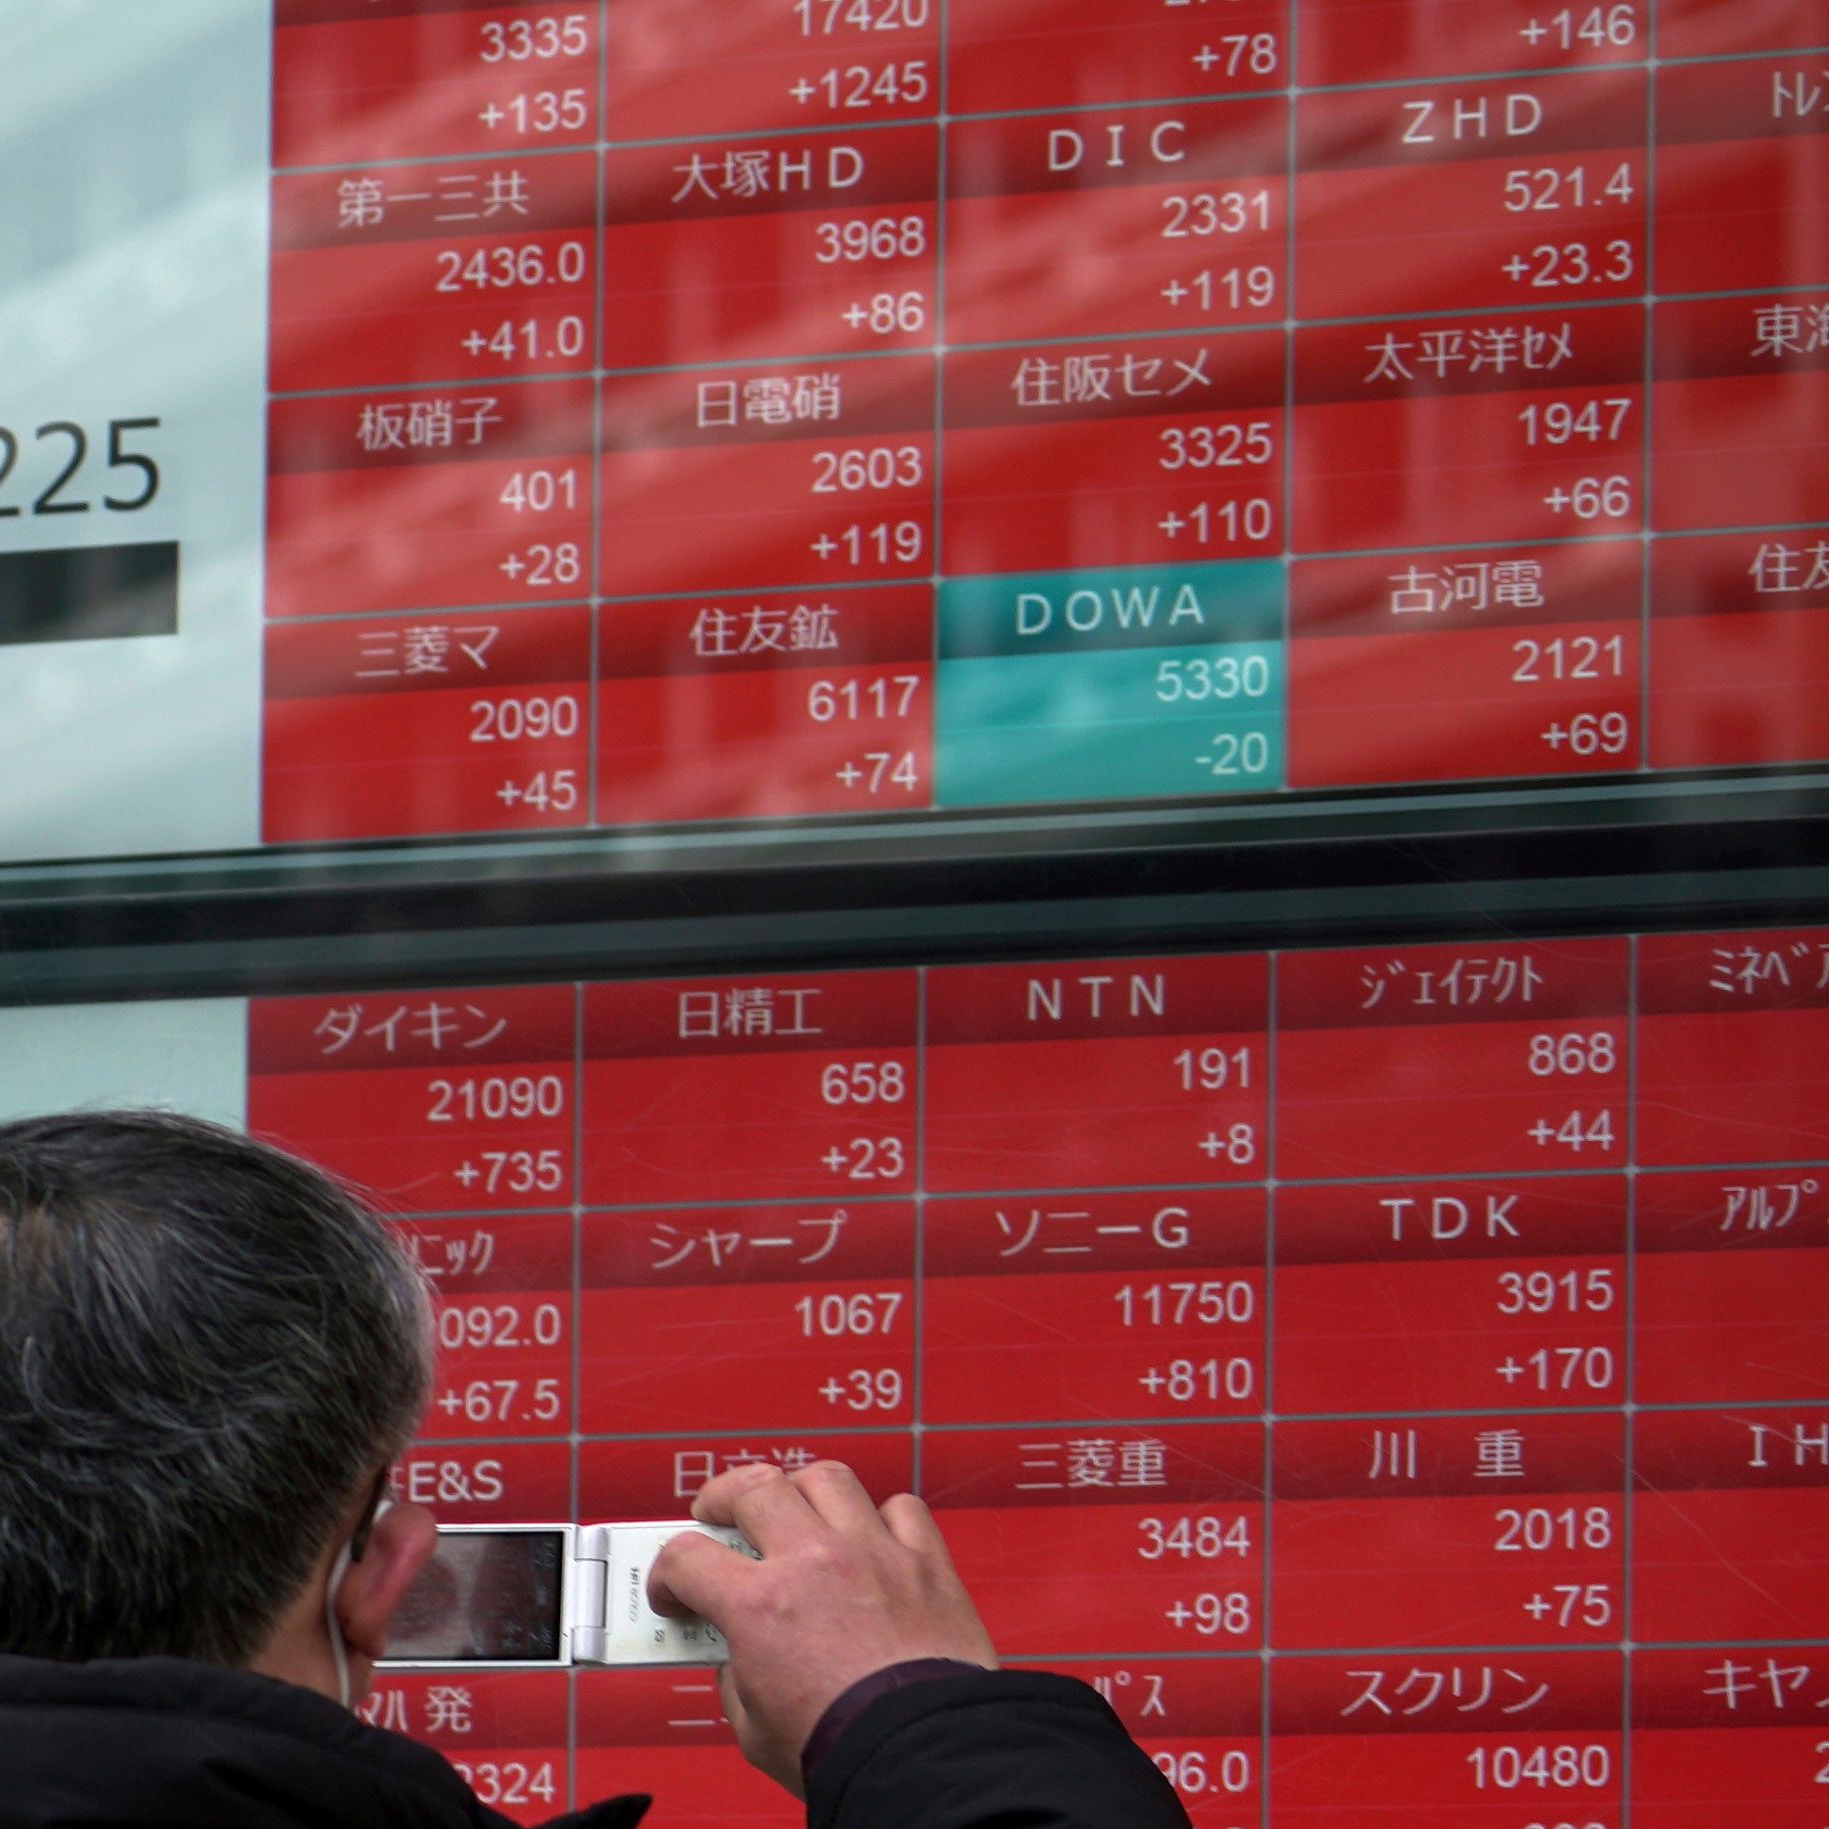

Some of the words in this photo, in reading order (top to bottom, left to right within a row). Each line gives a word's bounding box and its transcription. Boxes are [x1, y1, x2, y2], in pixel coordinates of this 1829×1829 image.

[481, 14, 588, 62] 3335
[1519, 3, 1635, 49] +146
[1193, 33, 1276, 77] +78
[789, 60, 927, 108] +1245
[480, 88, 587, 134] +135
[1504, 162, 1634, 212] 521.4
[1162, 189, 1269, 238] 2331
[815, 215, 925, 263] 3968
[436, 241, 585, 292] 2436.0
[1502, 239, 1633, 287] +23.3
[1161, 265, 1274, 310] +119
[841, 291, 924, 333] +86
[461, 315, 583, 359] +41.0
[1519, 397, 1631, 445] 1947
[1160, 422, 1272, 470] 3325
[499, 469, 575, 513] 401
[812, 445, 922, 493] 2603
[1543, 475, 1629, 518] +66
[811, 520, 922, 565] +119
[1158, 498, 1271, 543] +110
[500, 542, 580, 586] +28
[1156, 655, 1269, 703] 5330
[1512, 634, 1622, 682] 2121
[470, 695, 578, 742] 2090
[808, 675, 918, 722] 6117
[1196, 731, 1270, 775] -20
[1541, 711, 1627, 755] +69
[496, 769, 577, 811] +45
[836, 751, 917, 793] +74
[1174, 1047, 1249, 1090] 191
[1528, 1031, 1615, 1076] 868
[427, 1075, 563, 1122] 21090
[821, 1061, 904, 1105] 658
[1198, 1123, 1254, 1164] +8
[1527, 1109, 1615, 1151] +44
[454, 1149, 562, 1193] +735
[821, 1136, 904, 1179] +23
[1115, 1280, 1253, 1326] 11750
[1497, 1268, 1613, 1314] 3915
[796, 1292, 902, 1336] 1067
[819, 1368, 902, 1410] +39
[1139, 1357, 1253, 1401] +810
[1496, 1346, 1612, 1390] +170
[437, 1378, 559, 1422] +67.5
[1138, 1515, 1251, 1559] 3484
[1495, 1506, 1611, 1551] 2018
[1165, 1592, 1250, 1635] +98
[1523, 1584, 1610, 1627] +75
[1467, 1744, 1609, 1789] 10480
